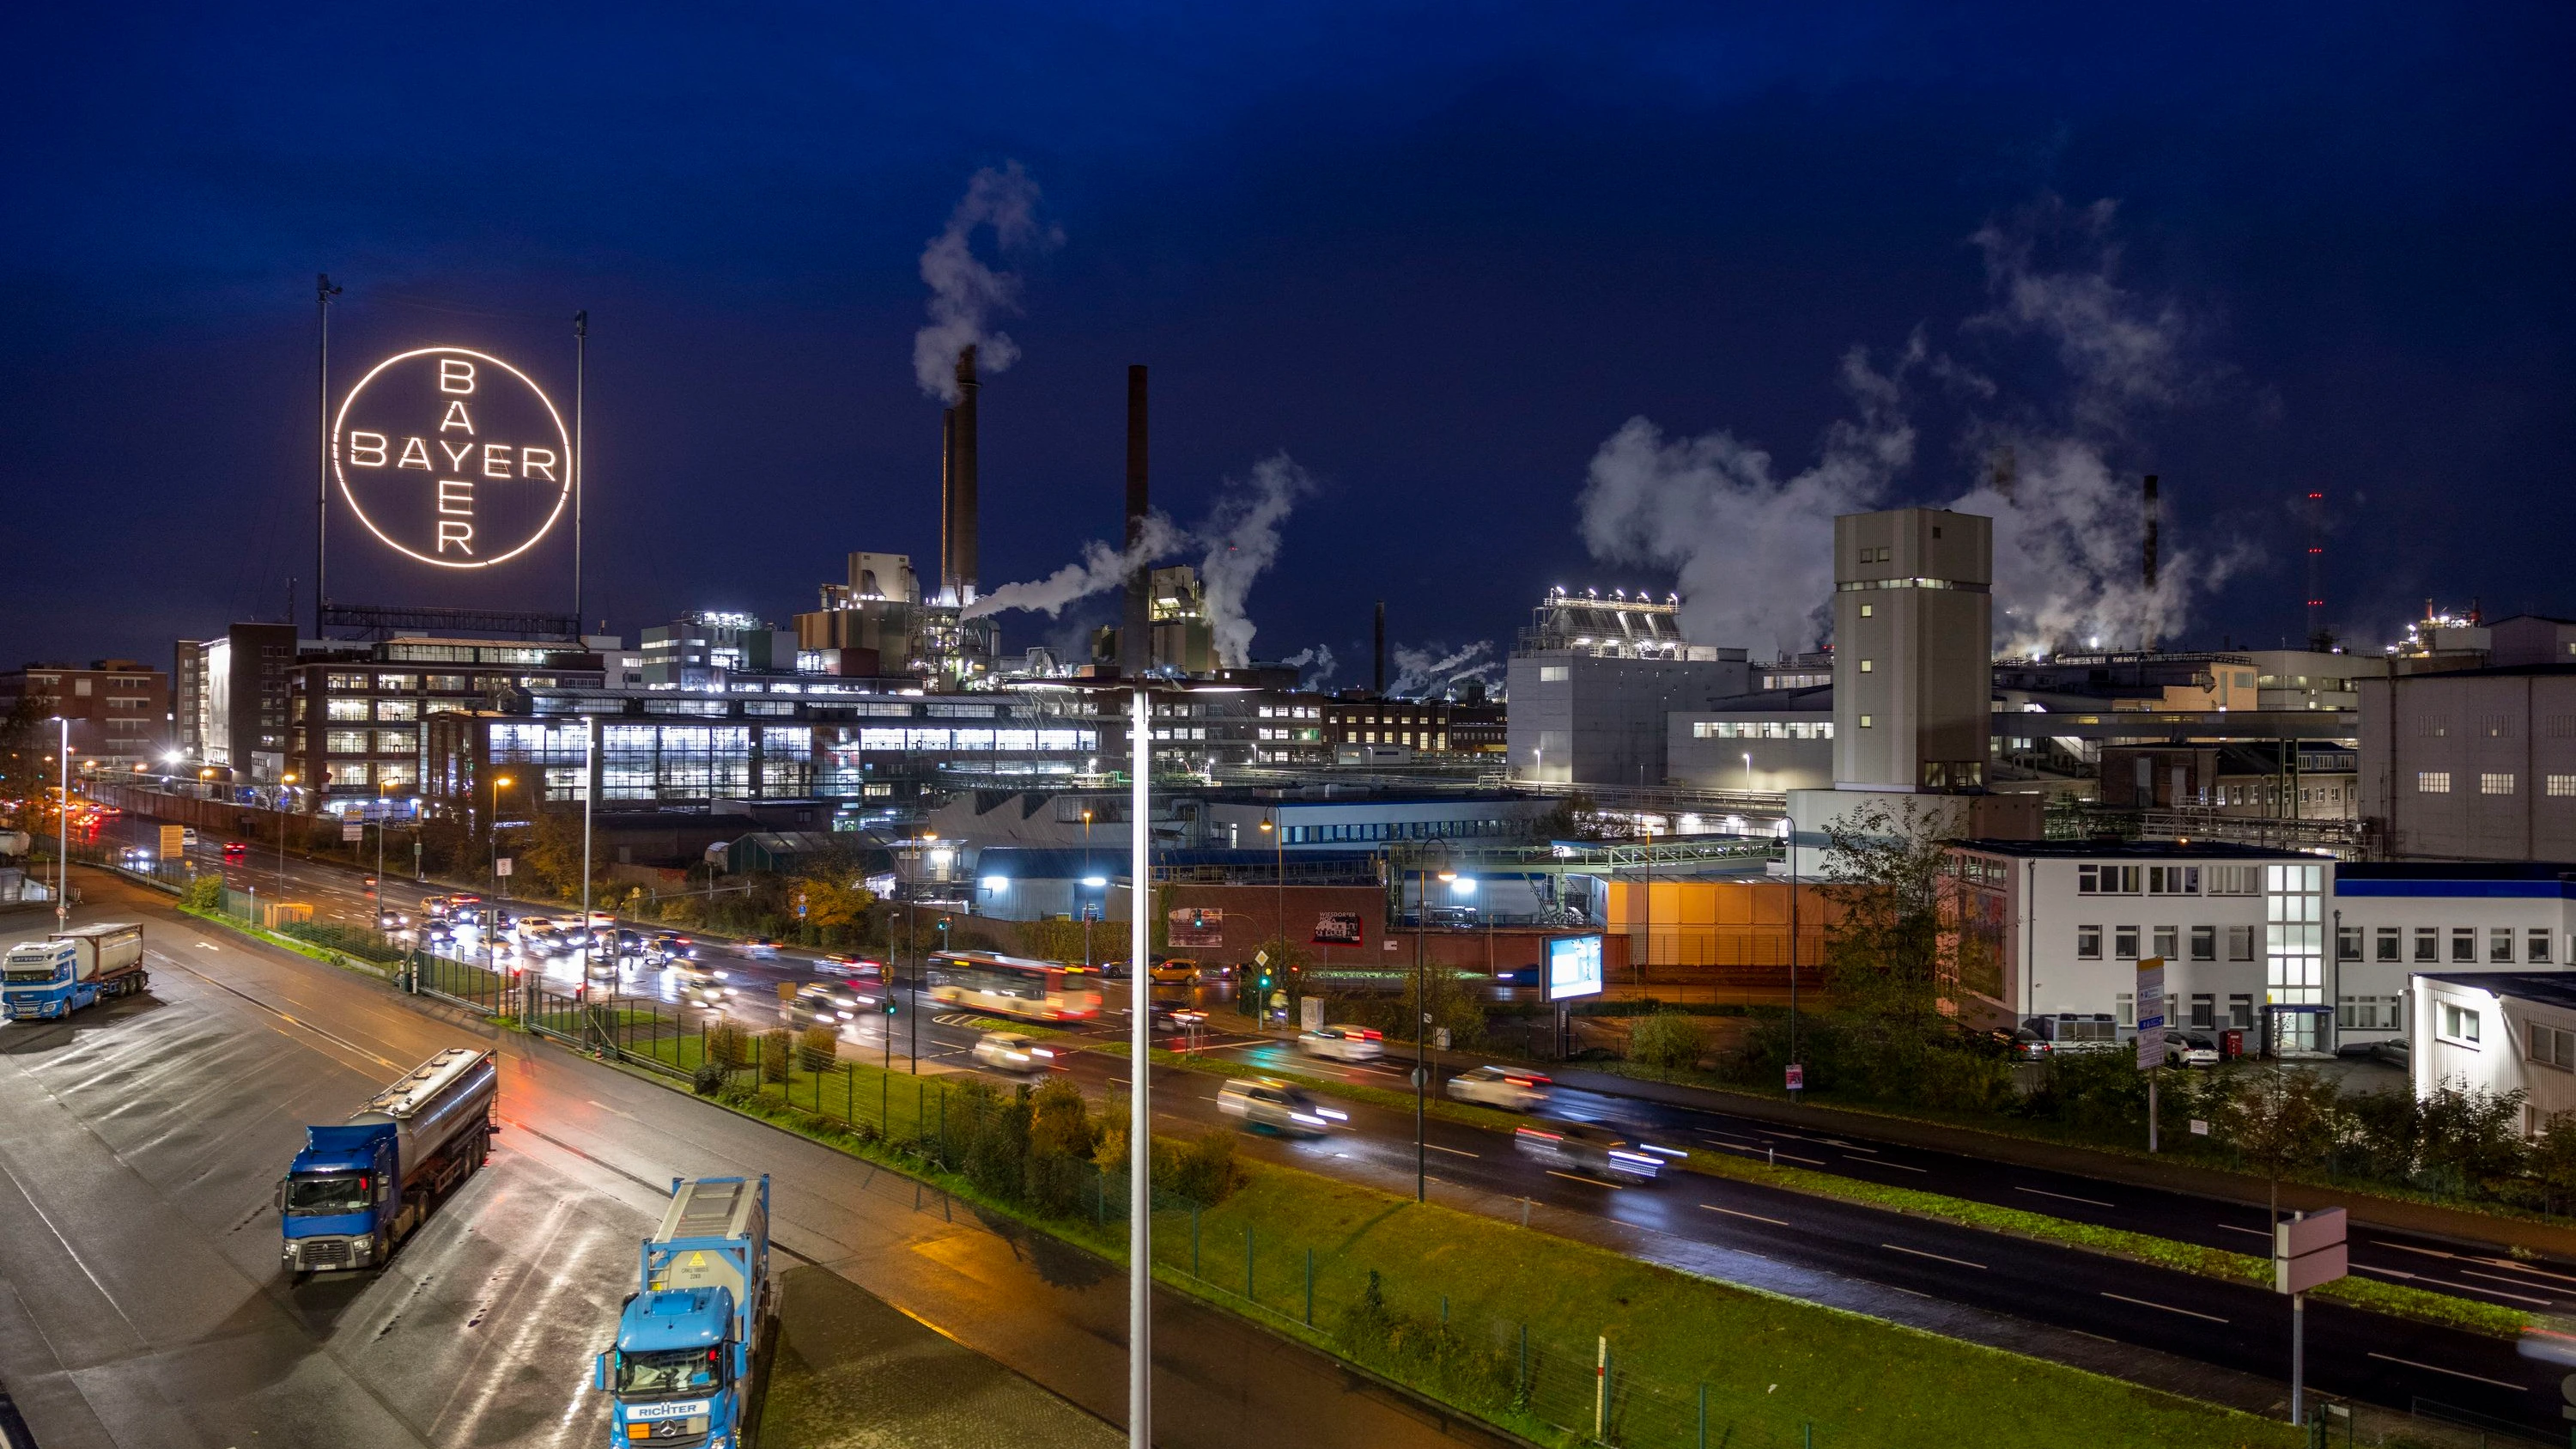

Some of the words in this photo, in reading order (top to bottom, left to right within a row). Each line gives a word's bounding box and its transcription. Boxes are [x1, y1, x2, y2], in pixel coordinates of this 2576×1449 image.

[350, 430, 556, 481] BAYER
[438, 359, 475, 555] BAYER
[639, 1404, 696, 1416] RICHTER
